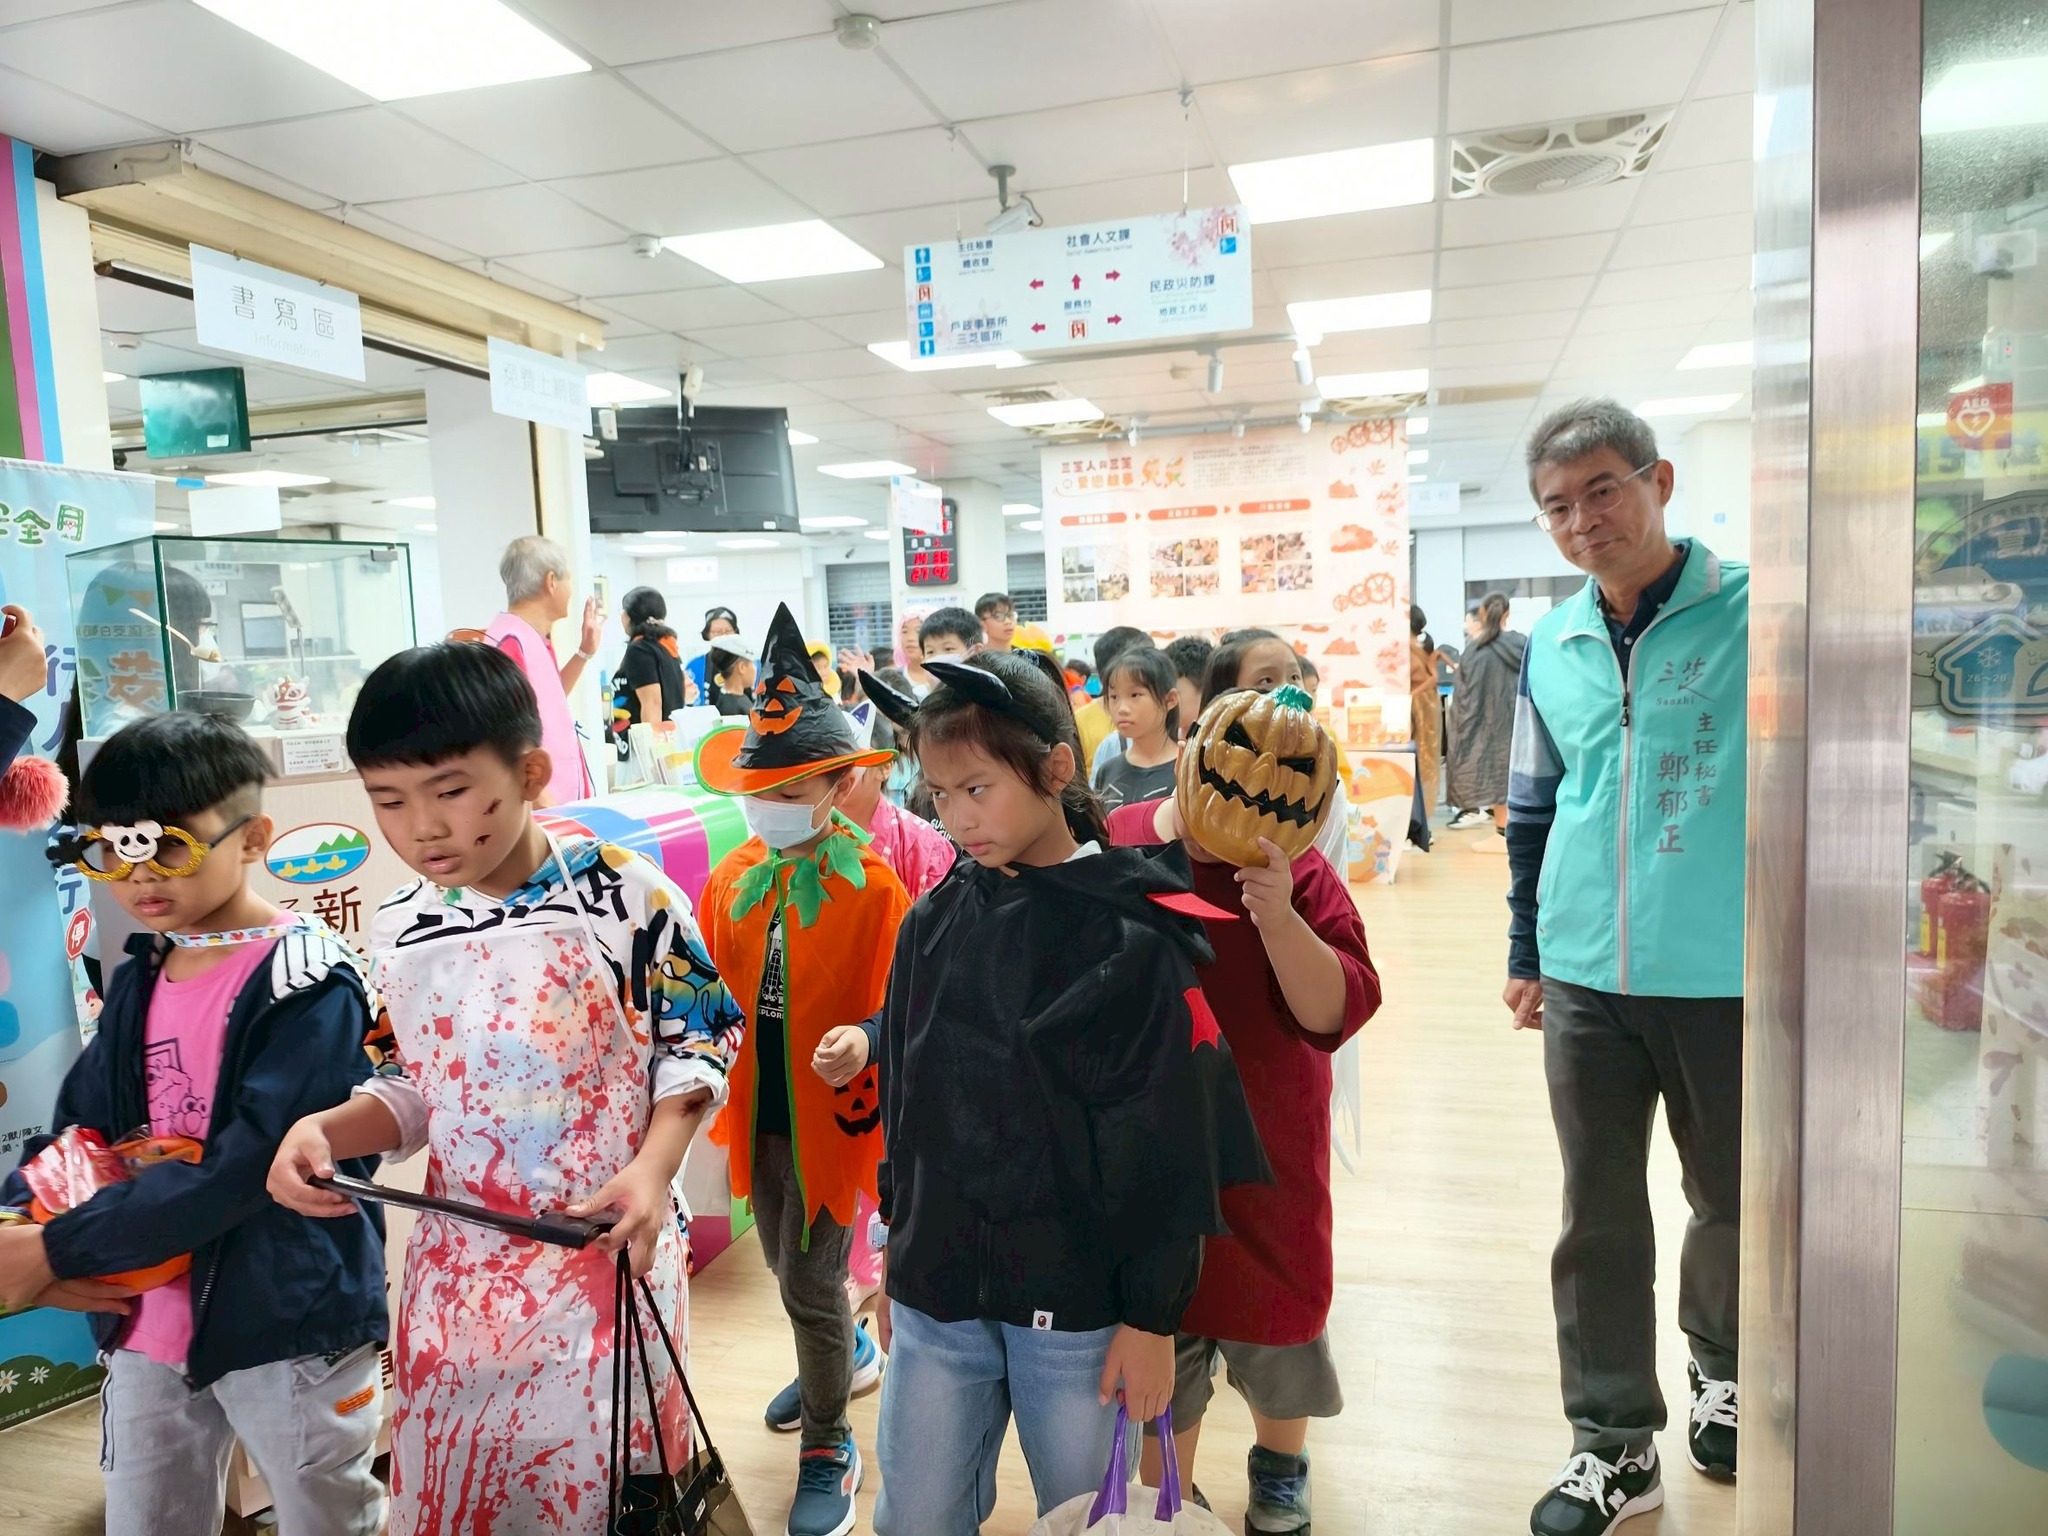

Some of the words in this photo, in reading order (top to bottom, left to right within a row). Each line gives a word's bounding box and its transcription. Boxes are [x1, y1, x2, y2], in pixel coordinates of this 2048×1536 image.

[231, 284, 336, 340] 書寫區
[1693, 711, 1719, 807] 主任秘書
[1655, 750, 1690, 854] 鄭郁正
[71, 920, 86, 950] 停
